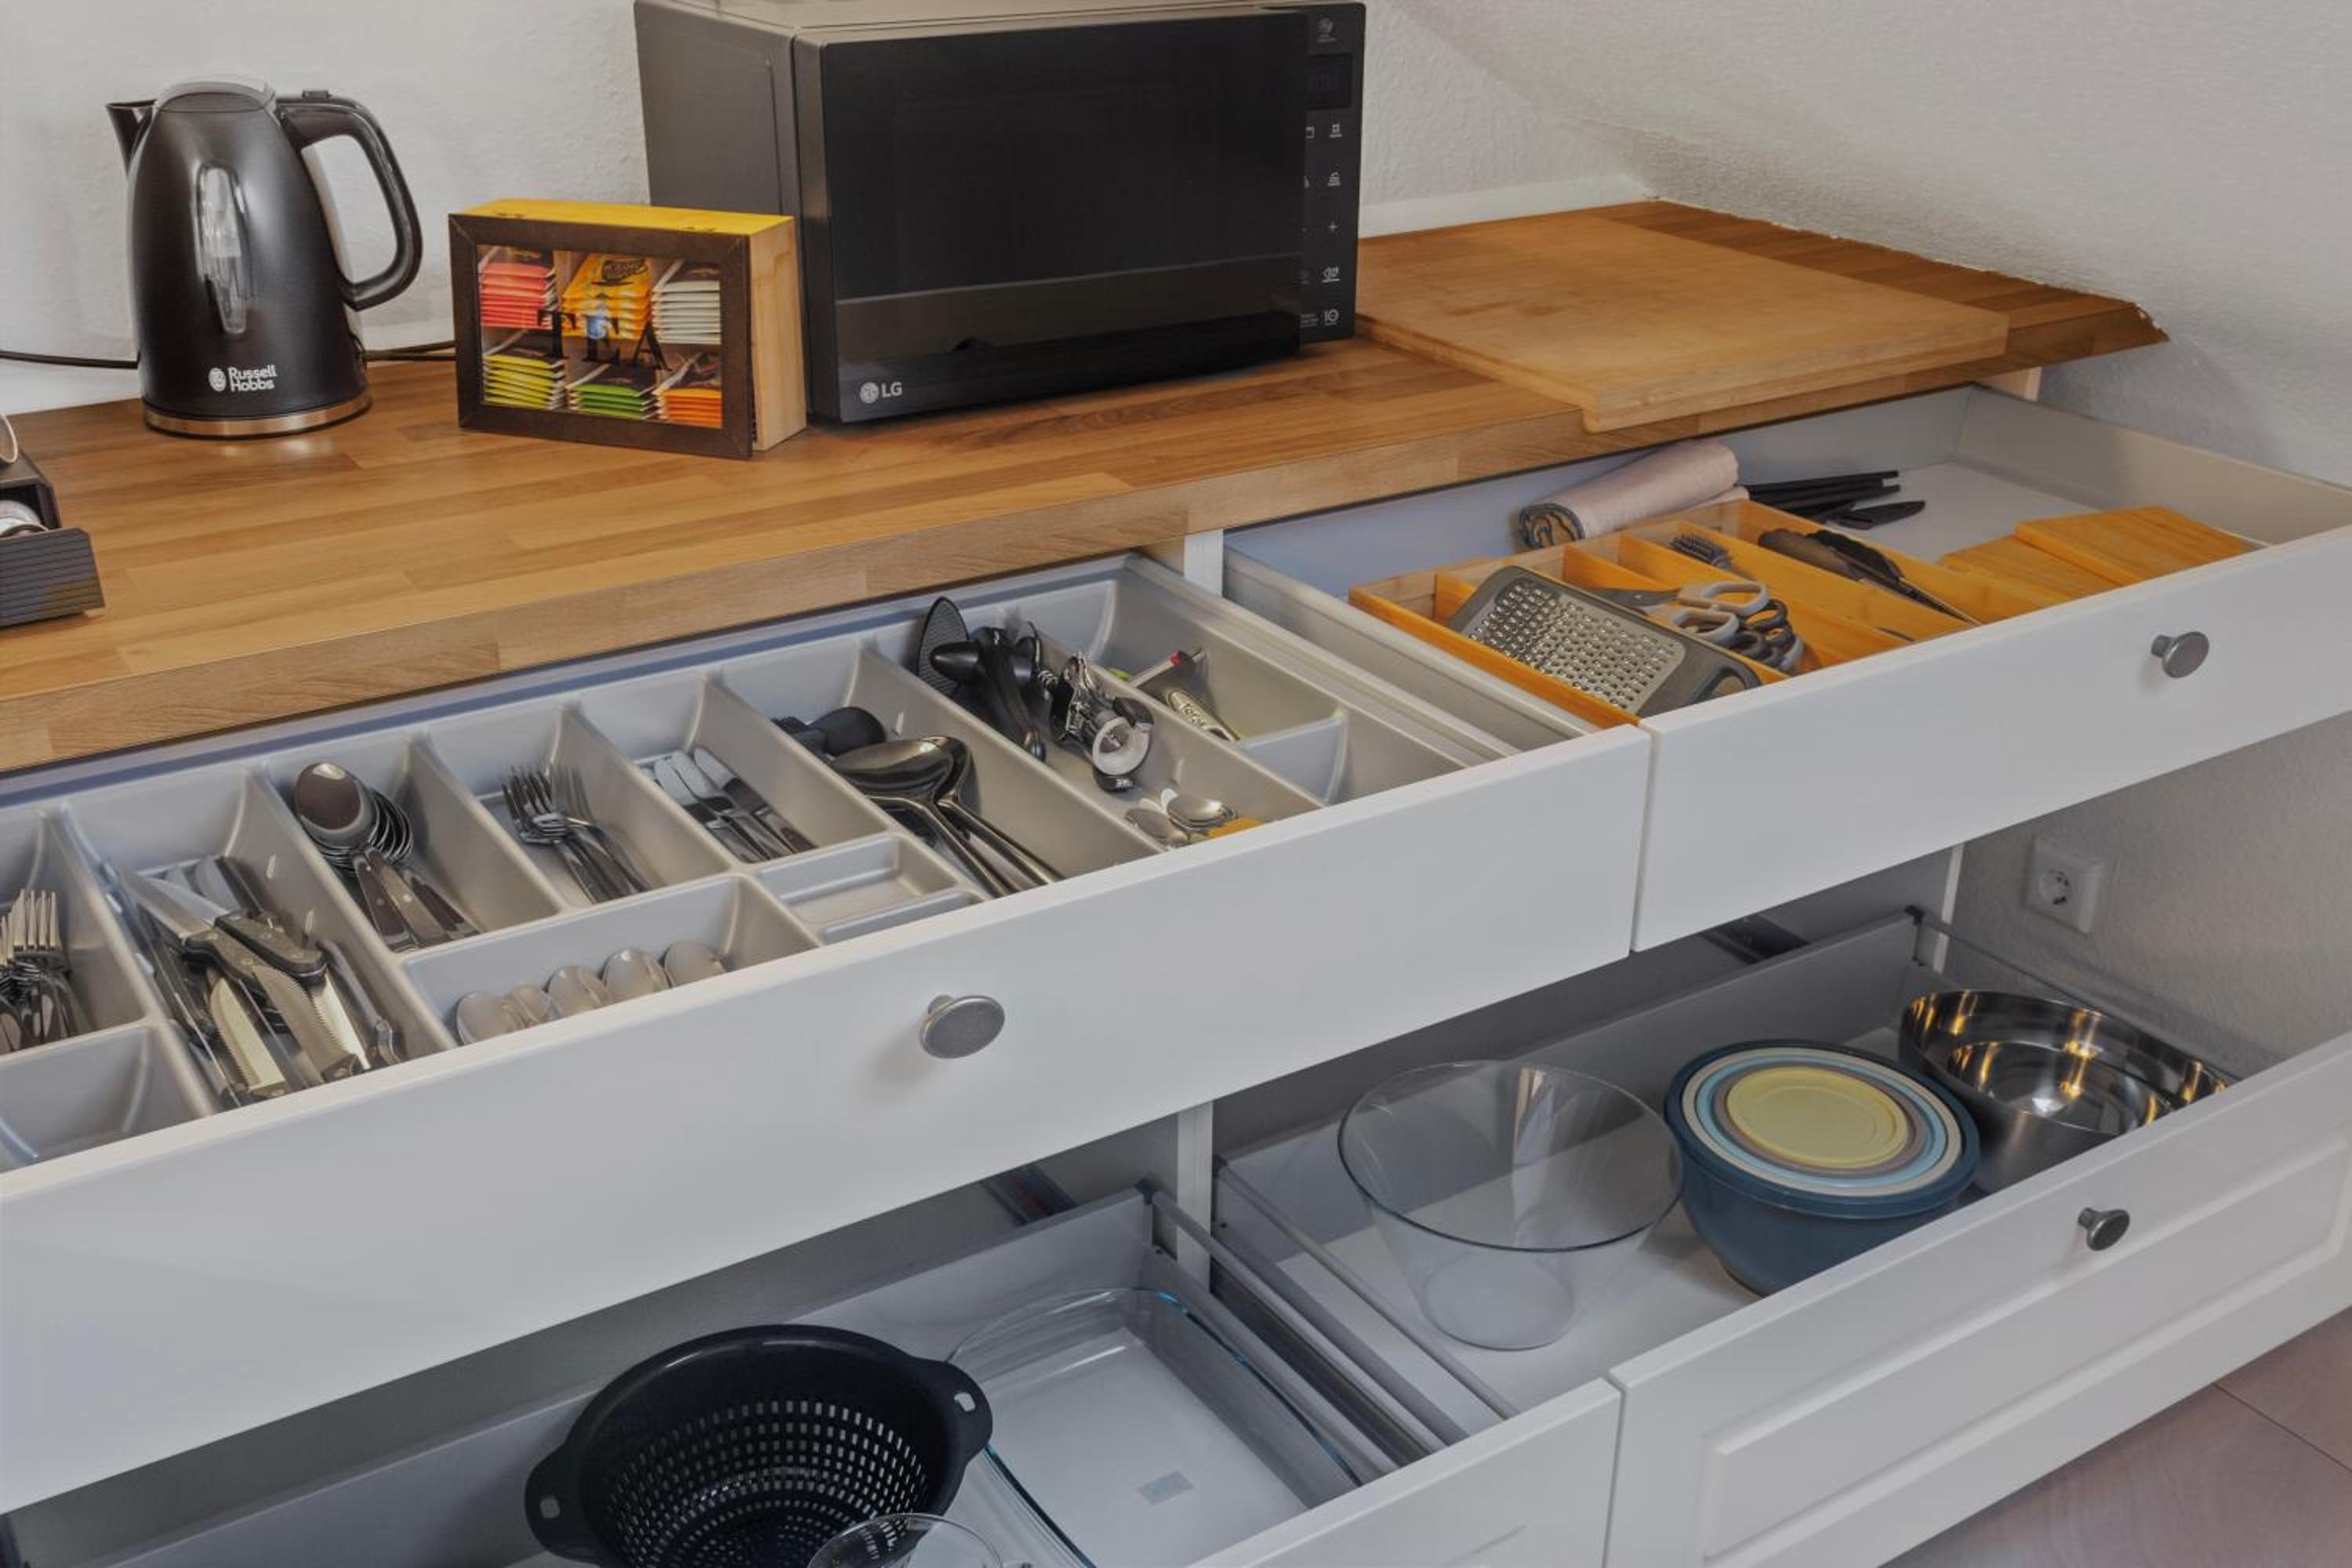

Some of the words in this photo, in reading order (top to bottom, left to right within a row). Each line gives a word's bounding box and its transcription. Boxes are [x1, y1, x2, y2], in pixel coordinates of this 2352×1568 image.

[537, 308, 673, 372] TEA
[227, 365, 278, 379] Russell
[230, 378, 275, 392] Hobbs
[881, 382, 902, 397] LG
